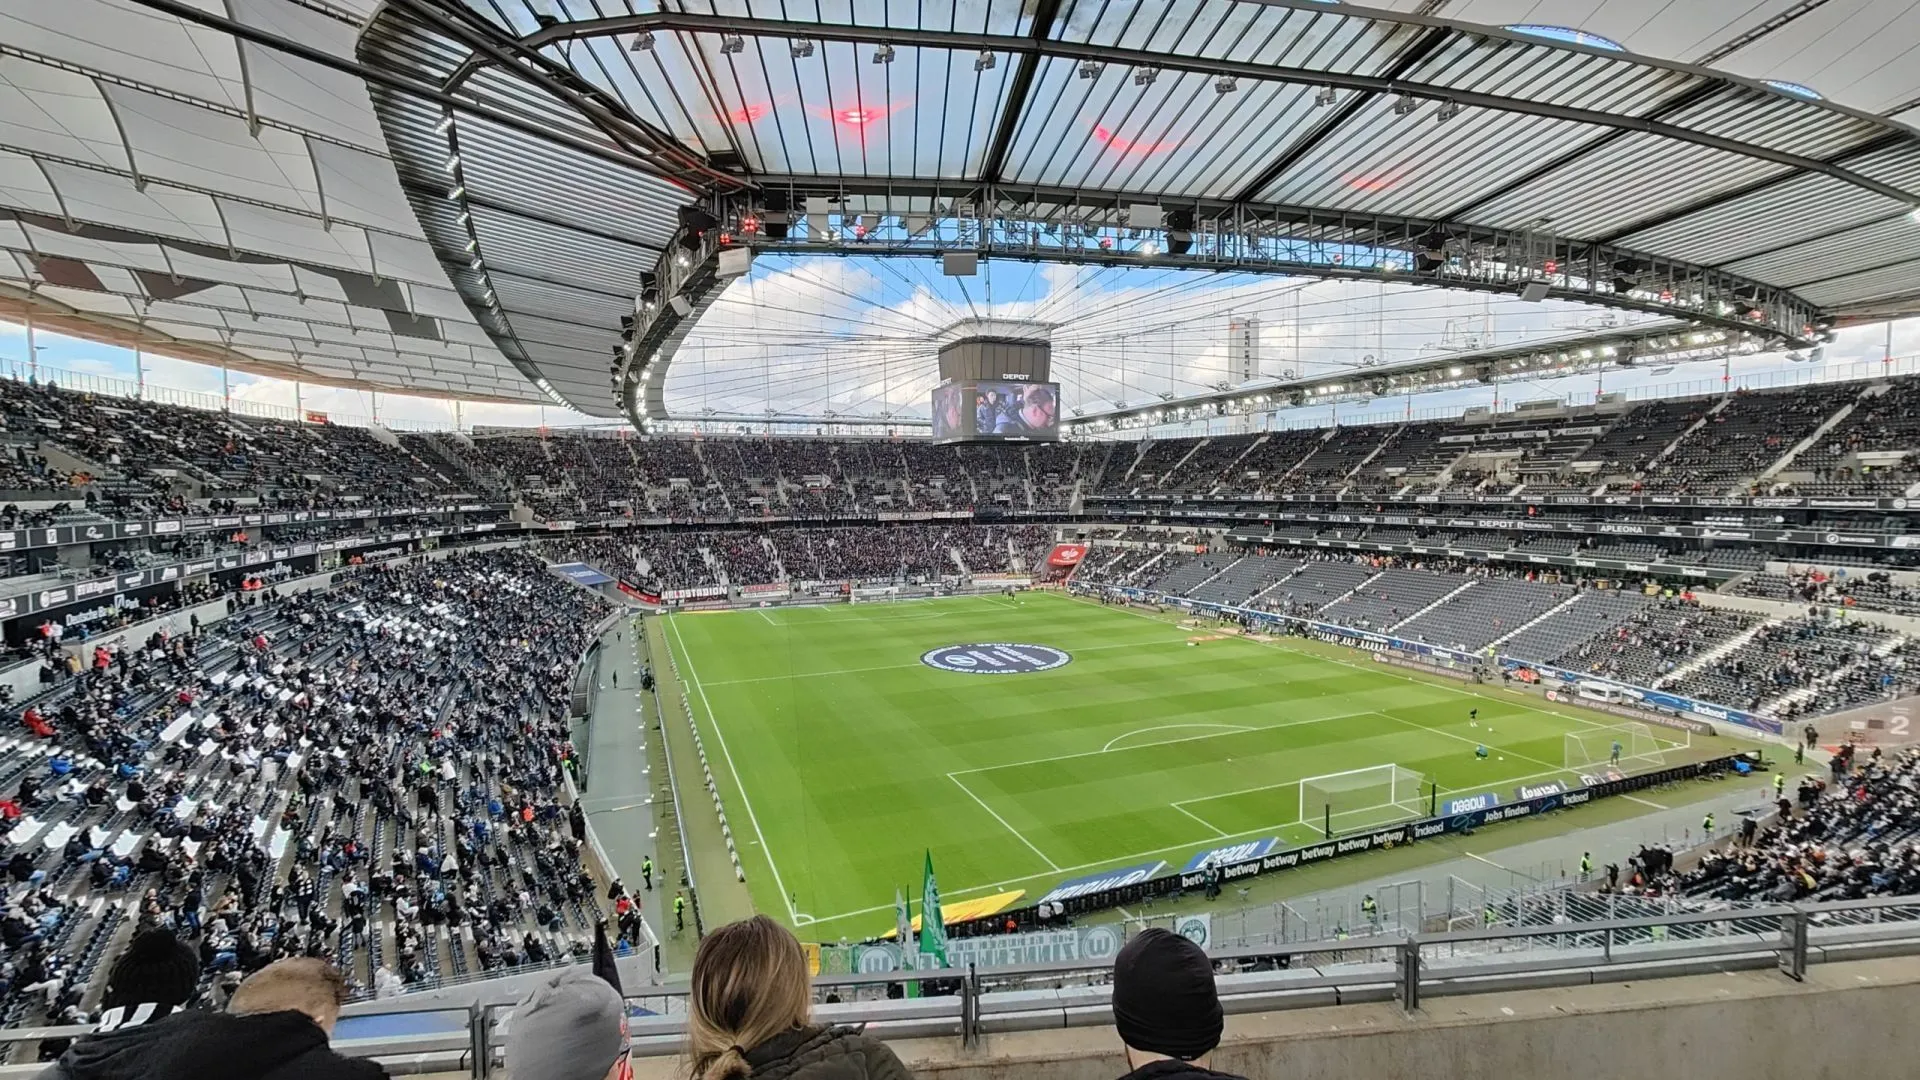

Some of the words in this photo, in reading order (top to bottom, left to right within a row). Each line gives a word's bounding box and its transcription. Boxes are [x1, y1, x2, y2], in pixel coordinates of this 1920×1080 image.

[1601, 526, 1643, 534] APLEONA
[661, 586, 728, 599] WALDSTADION
[1890, 715, 1910, 735] 2
[1484, 809, 1503, 822] Jobs
[1504, 804, 1530, 817] finden
[1224, 861, 1261, 879] betway
[1263, 852, 1299, 869] betway
[1301, 844, 1336, 860] betway
[1338, 837, 1371, 852] betway
[1373, 829, 1405, 845] betway
